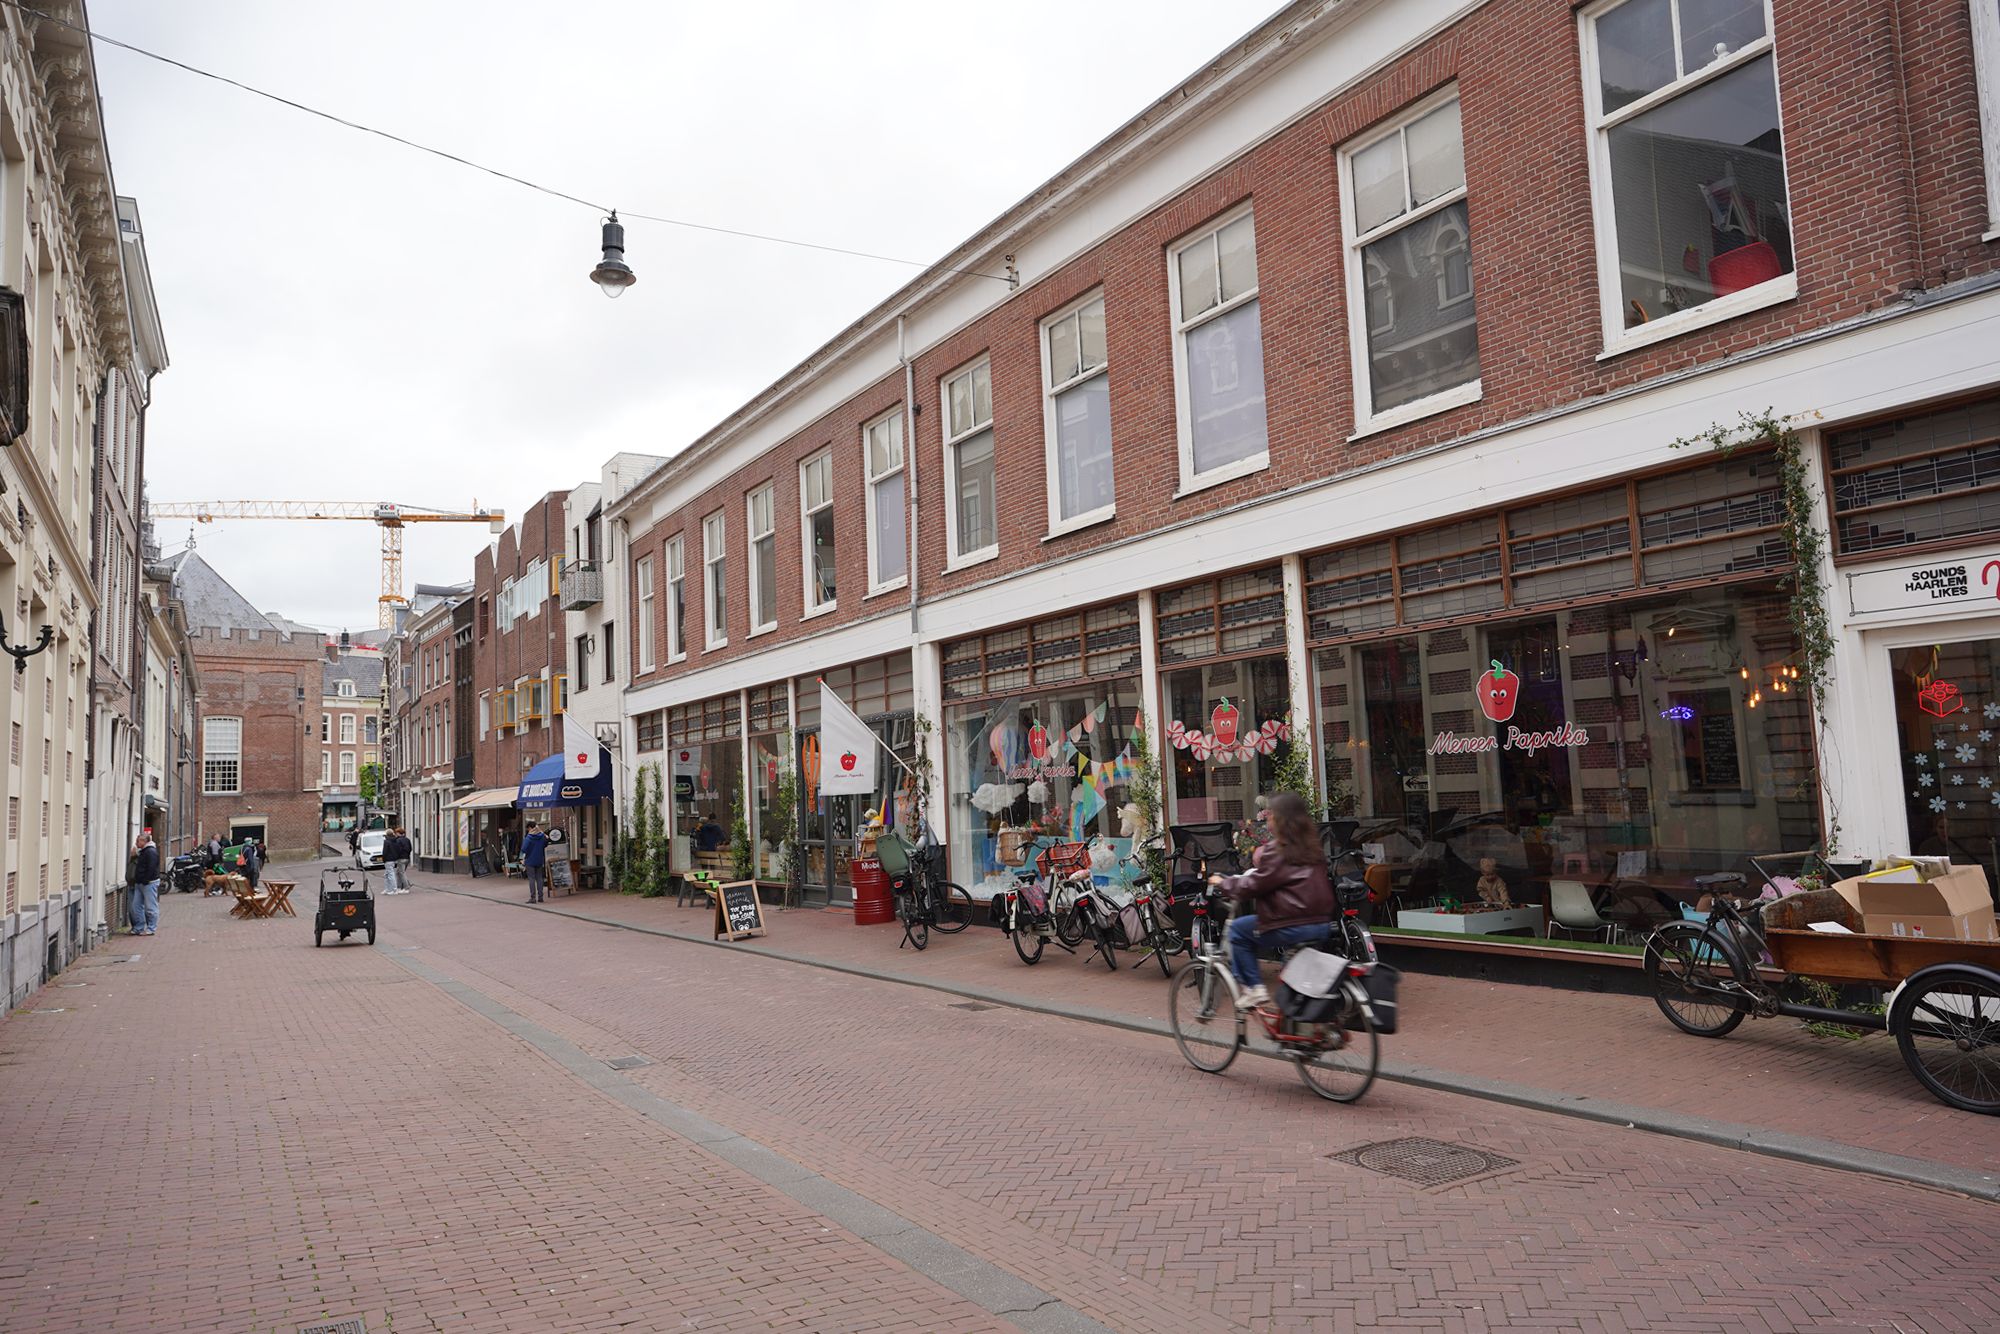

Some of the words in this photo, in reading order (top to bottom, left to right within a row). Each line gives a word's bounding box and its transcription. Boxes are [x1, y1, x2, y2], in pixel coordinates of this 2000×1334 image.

[1911, 565, 1966, 581] SOUNDS
[1905, 575, 1968, 592] HAARLEM
[1931, 586, 1968, 599] LIKES
[1427, 731, 1498, 755] Meneer
[1503, 721, 1589, 757] Paprika
